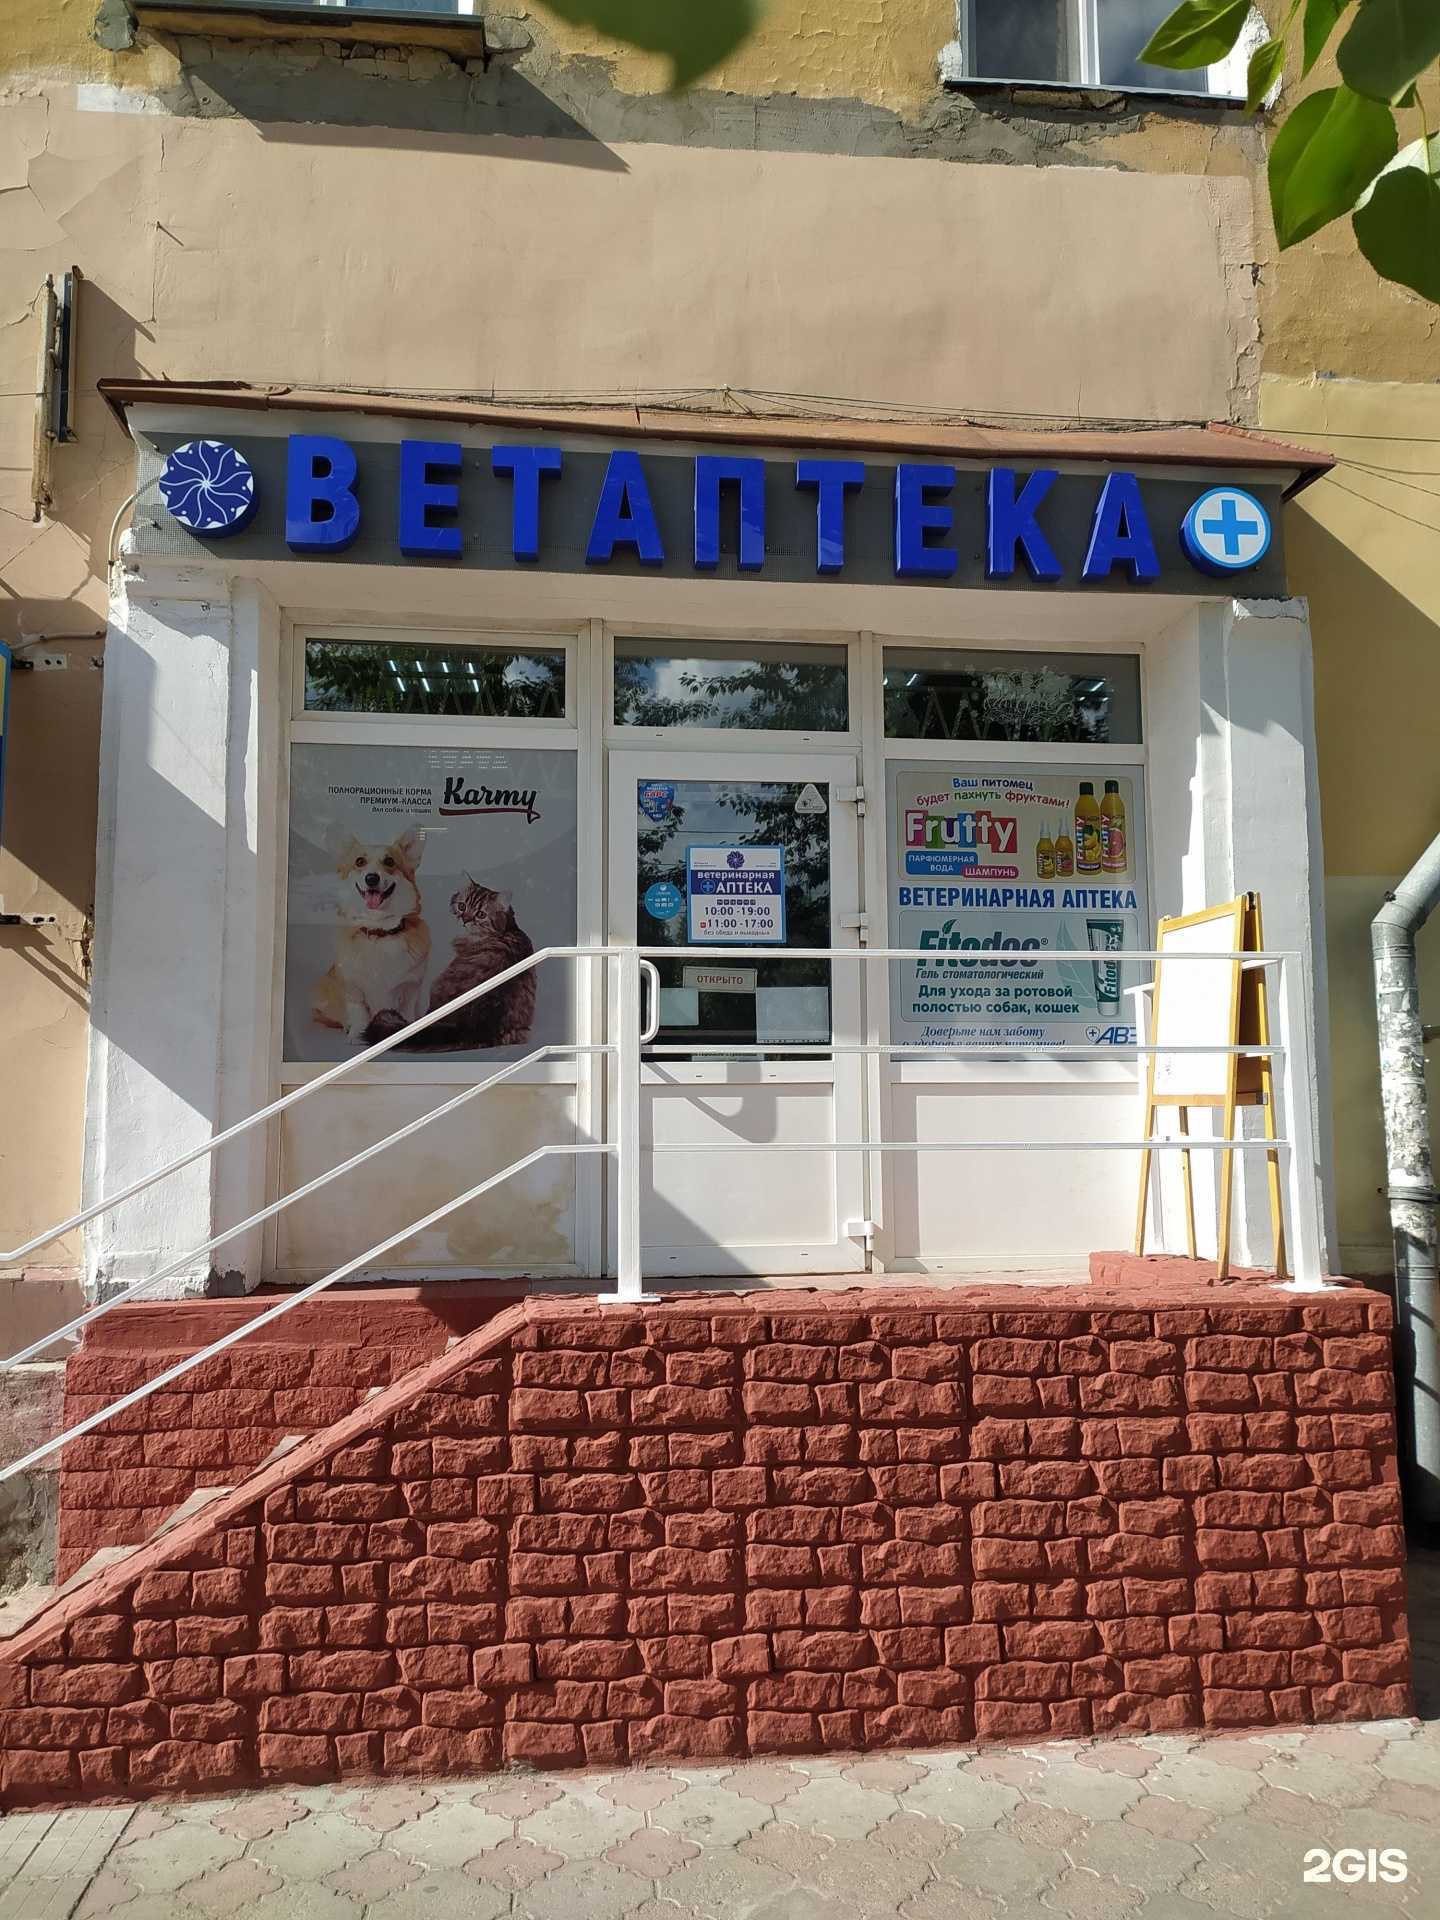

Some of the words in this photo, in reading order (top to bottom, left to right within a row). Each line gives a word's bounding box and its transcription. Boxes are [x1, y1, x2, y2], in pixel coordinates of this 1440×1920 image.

[286, 434, 1160, 583] ВЕТАПТЕКА
[328, 785, 403, 795] ПОЛНОРАЦИОННЫЕ
[405, 787, 432, 796] КОРМА
[952, 778, 979, 788] Ваш
[981, 779, 1033, 791] питомец
[360, 796, 432, 806] ПРЕМИУМ-КЛАССА
[443, 777, 537, 824] Karmy
[916, 792, 950, 806] будет
[953, 789, 1001, 801] пахнуть
[1005, 790, 1070, 809] фруктами!
[905, 810, 1017, 853] Frutty
[908, 855, 975, 863] ПАРФЮМЕРНАЯ
[930, 864, 954, 873] ВОДА
[965, 866, 1016, 877] ШАМПУНЬ
[697, 871, 775, 881] ветеринарная
[716, 881, 773, 894] АПТЕКА
[899, 887, 1055, 908] ВЕТЕРИНАРНАЯ
[1062, 889, 1137, 909] АПТЕКА
[704, 906, 734, 916] 10:00
[708, 918, 737, 929] 11:00
[917, 929, 1041, 967] Fitodoc
[696, 974, 744, 985] ОТКРЫТО
[915, 969, 939, 979] Гель
[942, 969, 1044, 980] стоматологический
[919, 985, 946, 998] Для
[950, 987, 991, 999] ухода
[995, 988, 1009, 997] за
[1014, 985, 1073, 1000] ротовой
[912, 1003, 982, 1013] полостью
[986, 1000, 1031, 1015] собак,
[1035, 1003, 1080, 1013] кошек
[920, 1026, 976, 1039] Доверьте
[979, 1028, 1001, 1036] нам
[1003, 1026, 1045, 1039] заботу
